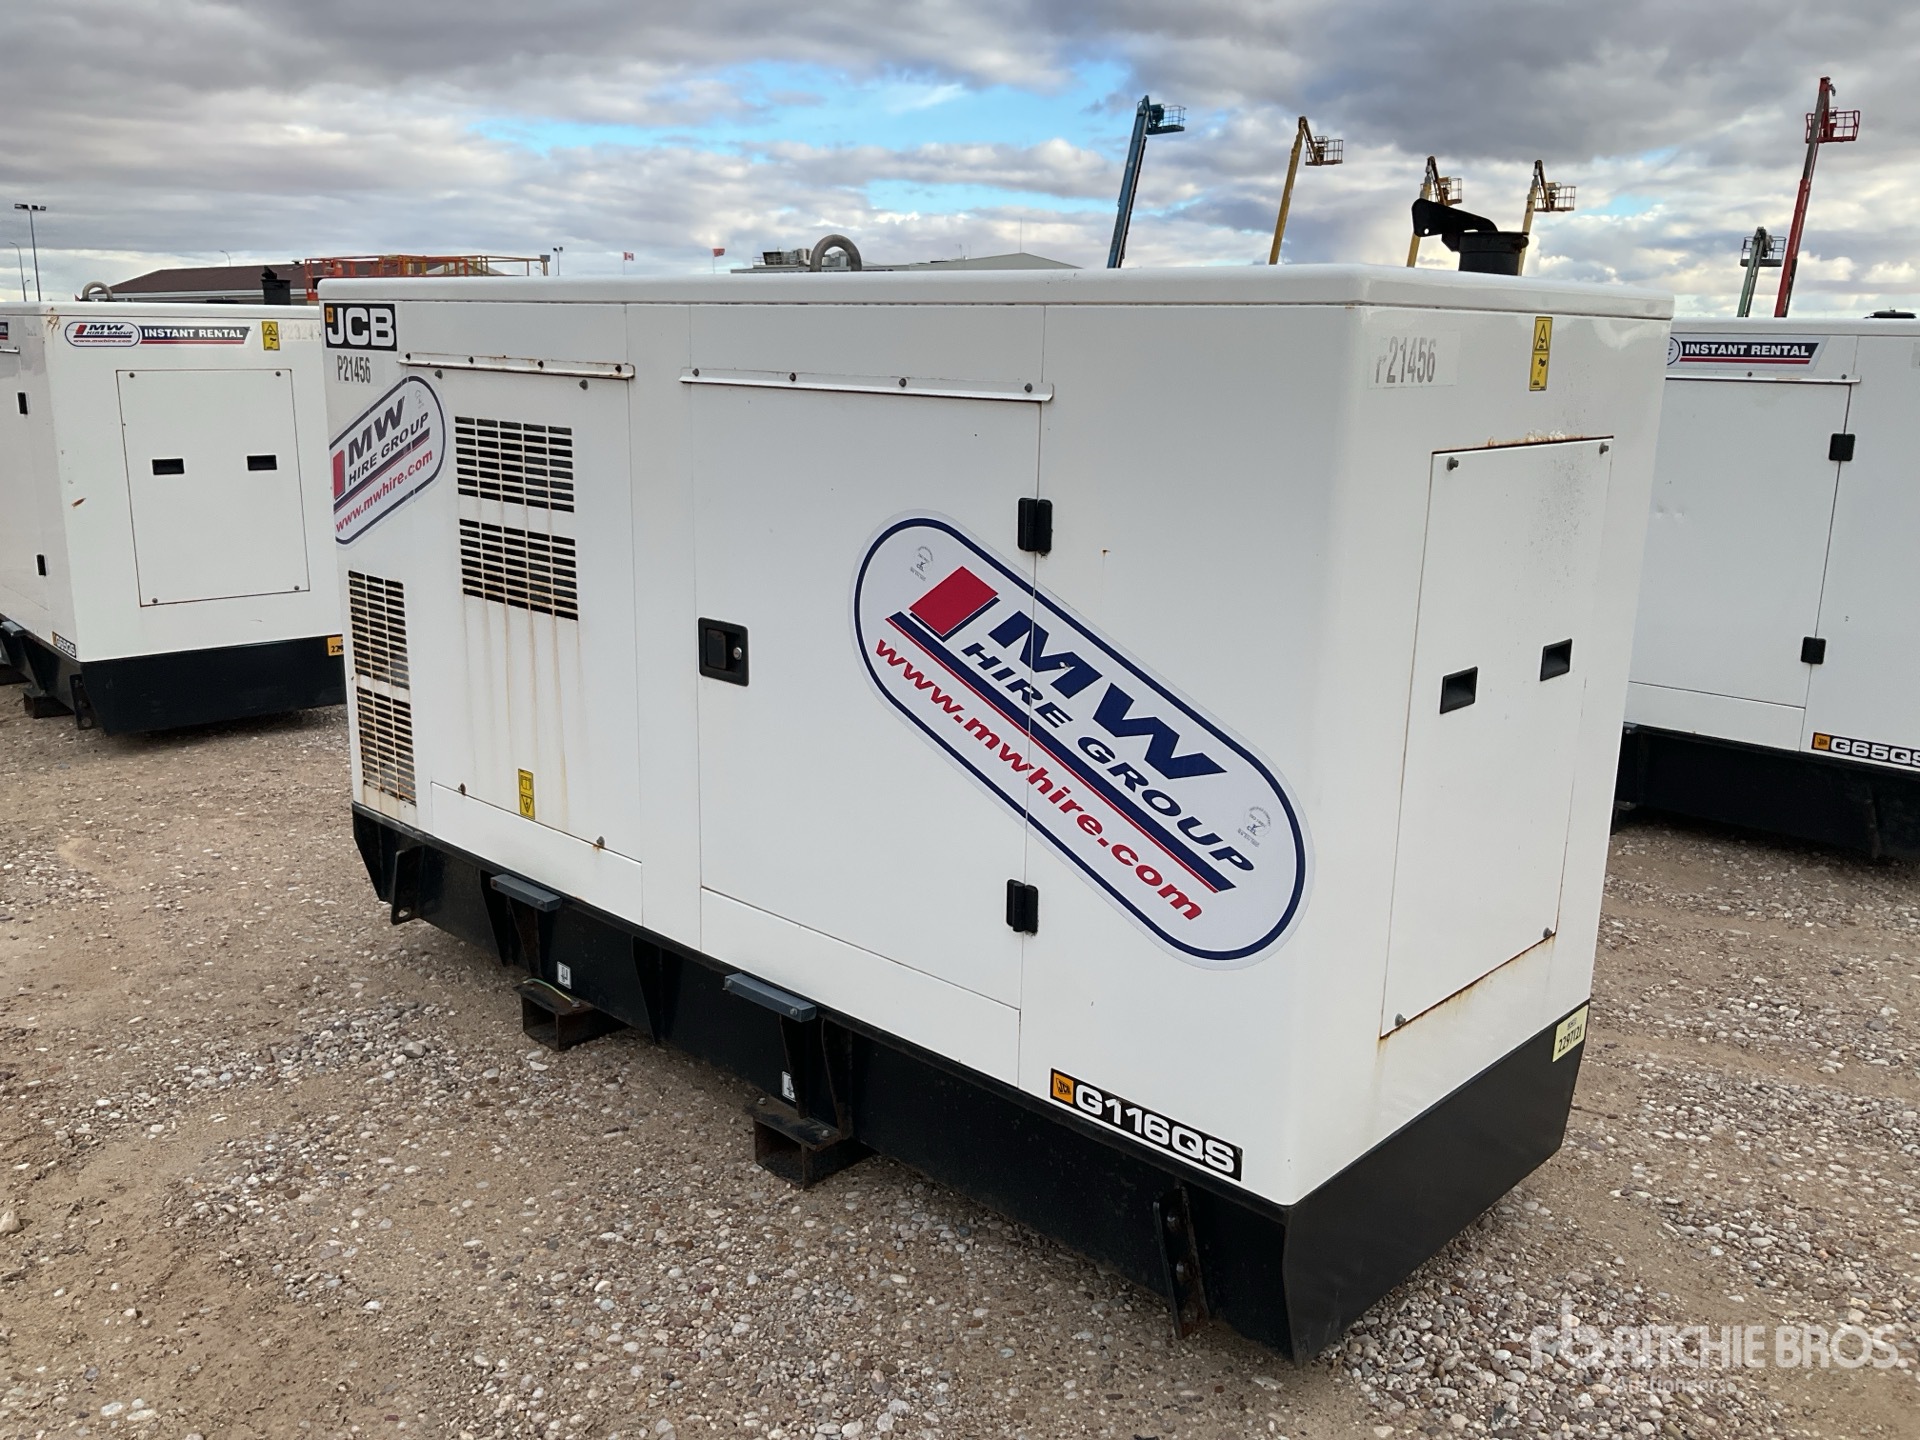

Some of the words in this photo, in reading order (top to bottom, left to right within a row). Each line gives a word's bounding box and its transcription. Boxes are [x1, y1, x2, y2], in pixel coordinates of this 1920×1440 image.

[144, 328, 196, 338] INSTANT
[198, 328, 244, 338] RENTAL
[327, 307, 395, 347] JCB
[1685, 343, 1748, 355] INSTANT
[1750, 344, 1810, 356] RENTAL
[336, 354, 371, 384] P21456
[348, 396, 406, 468] MW
[348, 453, 378, 487] HIRE
[381, 412, 429, 458] GROUP
[336, 450, 433, 533] www.mwhire.com
[984, 610, 1228, 781] MW
[875, 638, 1204, 921] www.mwhire.com
[962, 642, 1074, 730] HIRE
[1077, 735, 1256, 873] GROUP
[1075, 1084, 1235, 1173] G116QS
